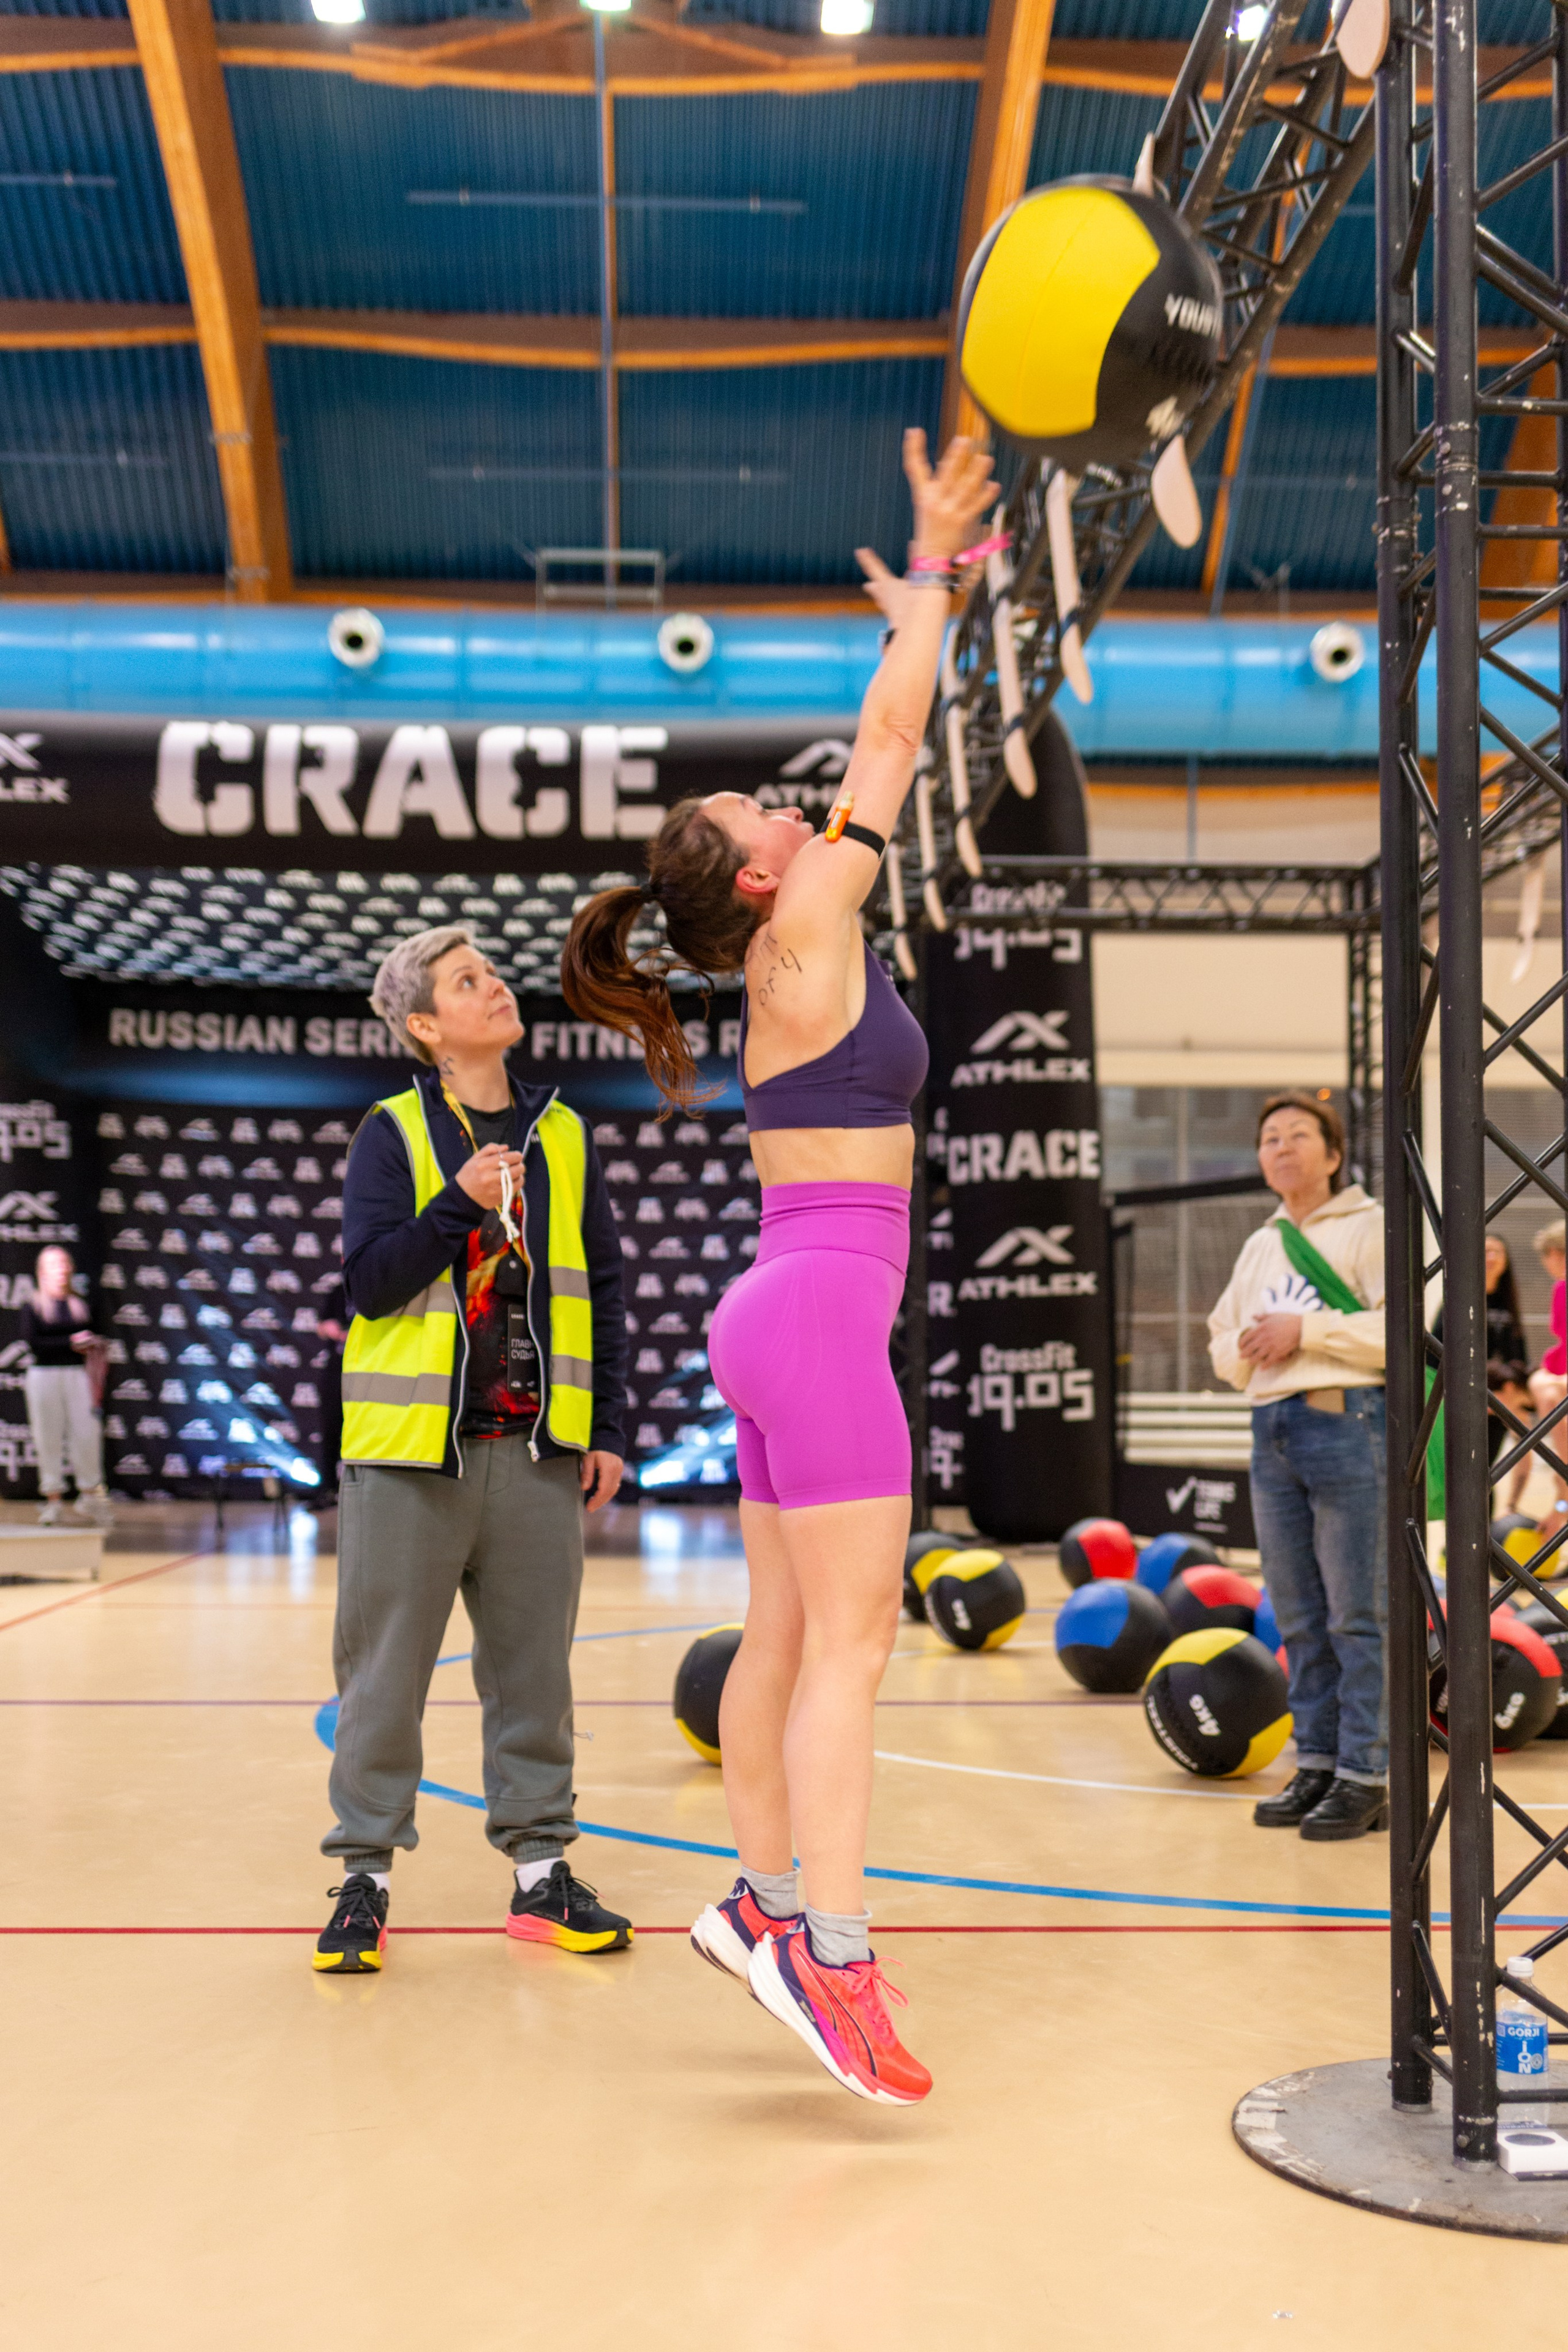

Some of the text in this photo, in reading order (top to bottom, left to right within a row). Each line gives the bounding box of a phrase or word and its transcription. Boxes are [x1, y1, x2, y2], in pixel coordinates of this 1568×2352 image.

[153, 721, 669, 840] CRACE
[109, 1008, 297, 1055] RUSSIAN
[305, 1017, 420, 1058] SERI
[530, 1019, 710, 1060] FITNES
[951, 1058, 1090, 1088] ATHLEX
[947, 1129, 1101, 1185] CRACE
[957, 1272, 1098, 1301] ATHLEX
[967, 1368, 1095, 1433] 19.05
[1507, 2027, 1540, 2037] GORJI
